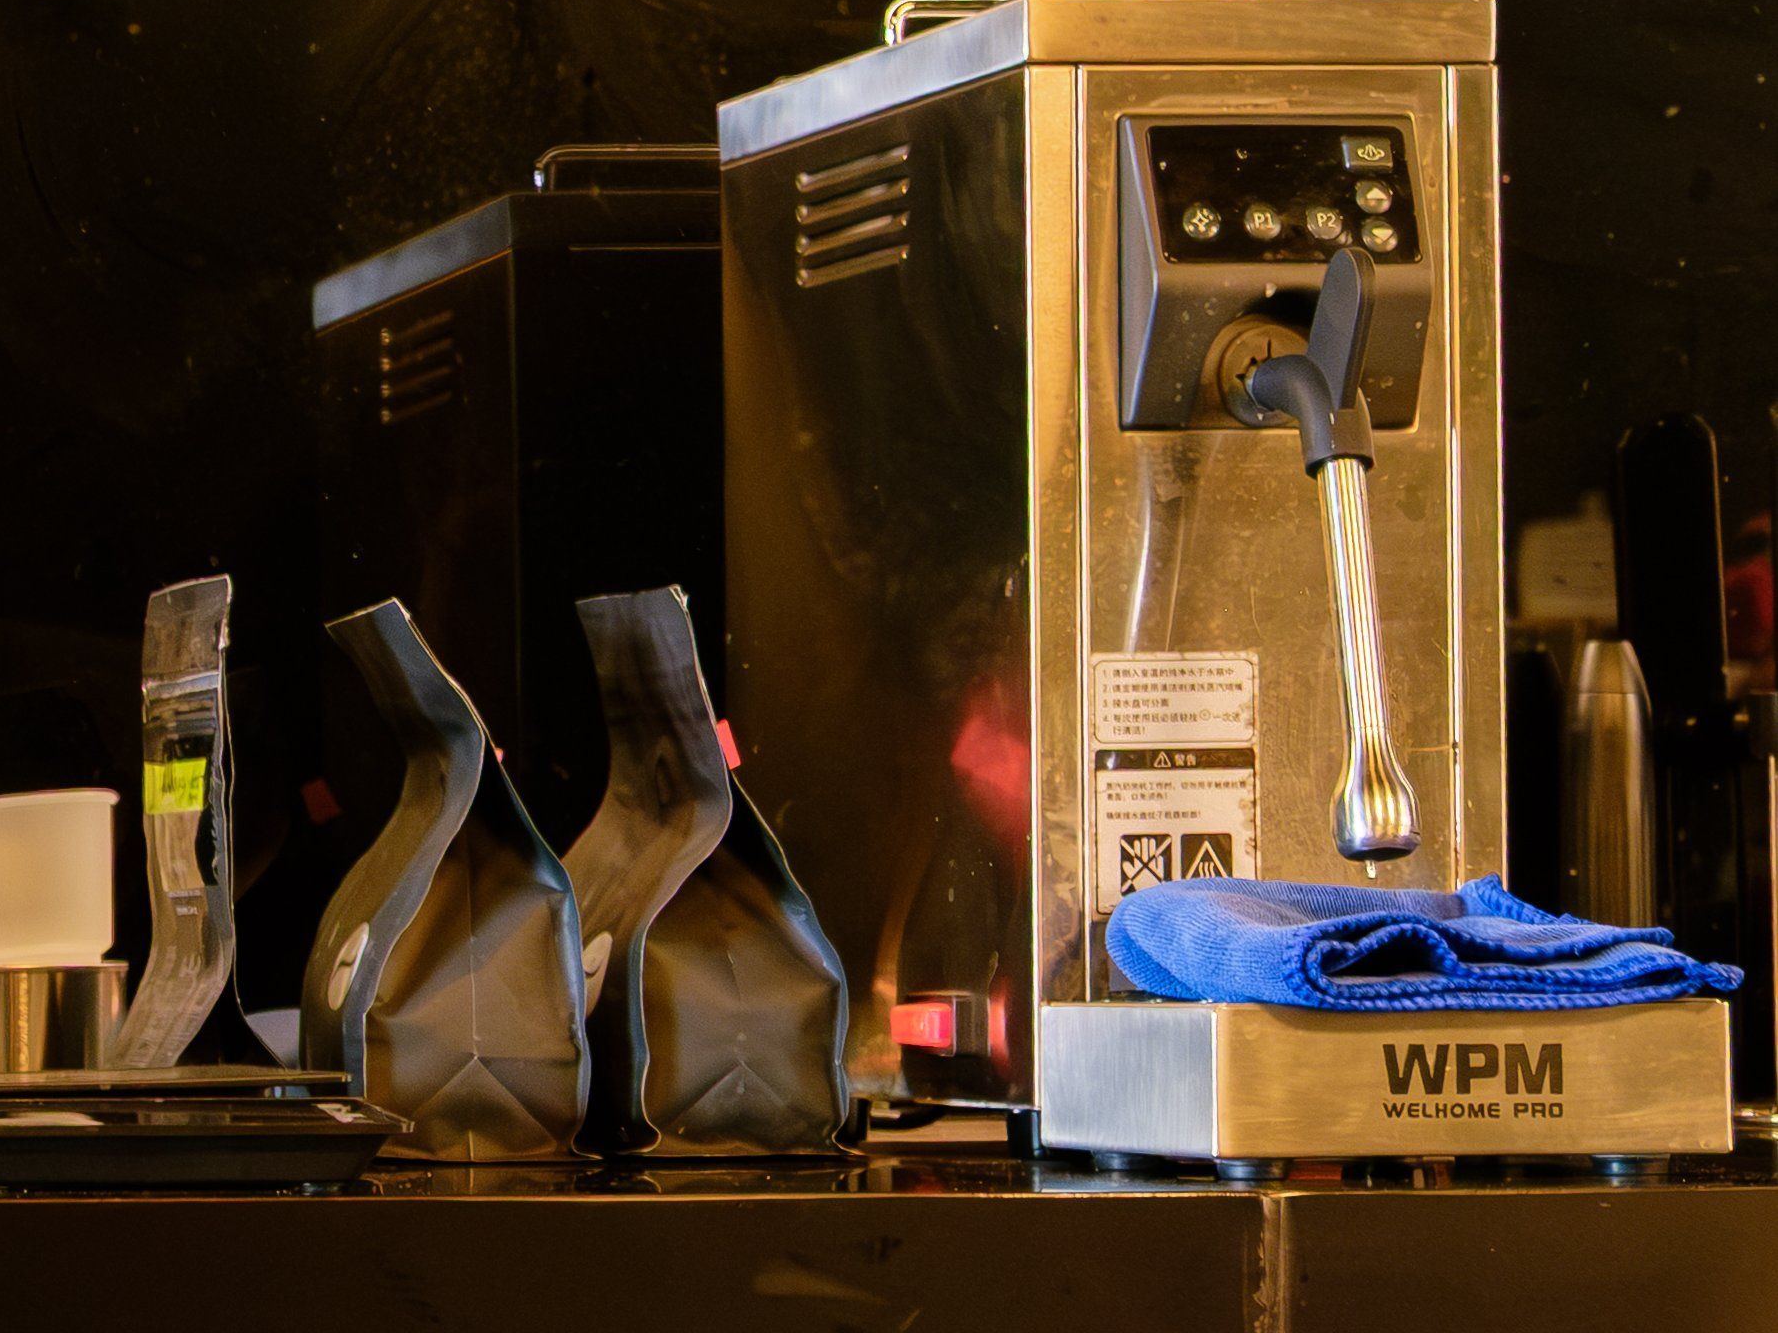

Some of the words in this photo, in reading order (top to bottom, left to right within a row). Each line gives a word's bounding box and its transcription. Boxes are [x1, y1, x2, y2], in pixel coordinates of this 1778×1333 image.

[1252, 211, 1274, 229] P1
[1315, 211, 1338, 229] P2
[1382, 1043, 1564, 1096] WPM
[1383, 1102, 1501, 1120] WELHOME
[1513, 1102, 1564, 1119] PRO
